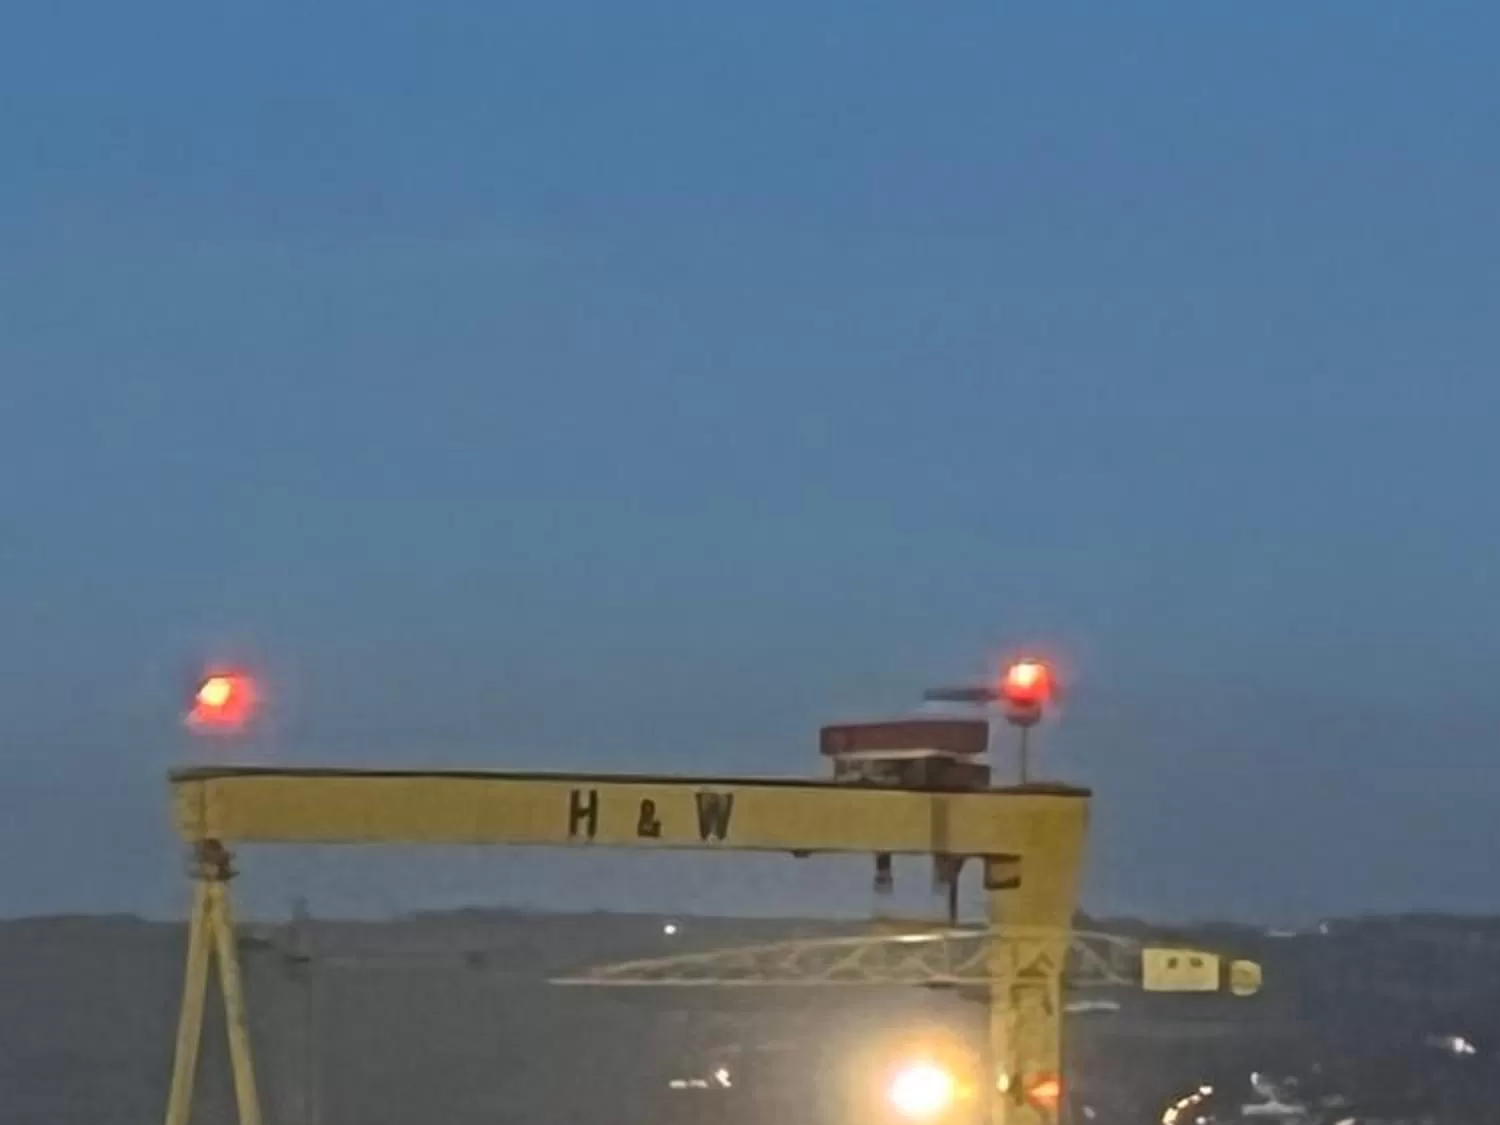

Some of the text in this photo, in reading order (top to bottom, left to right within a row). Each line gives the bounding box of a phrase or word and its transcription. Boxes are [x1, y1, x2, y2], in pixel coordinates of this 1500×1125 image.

[569, 789, 734, 841] H & W
